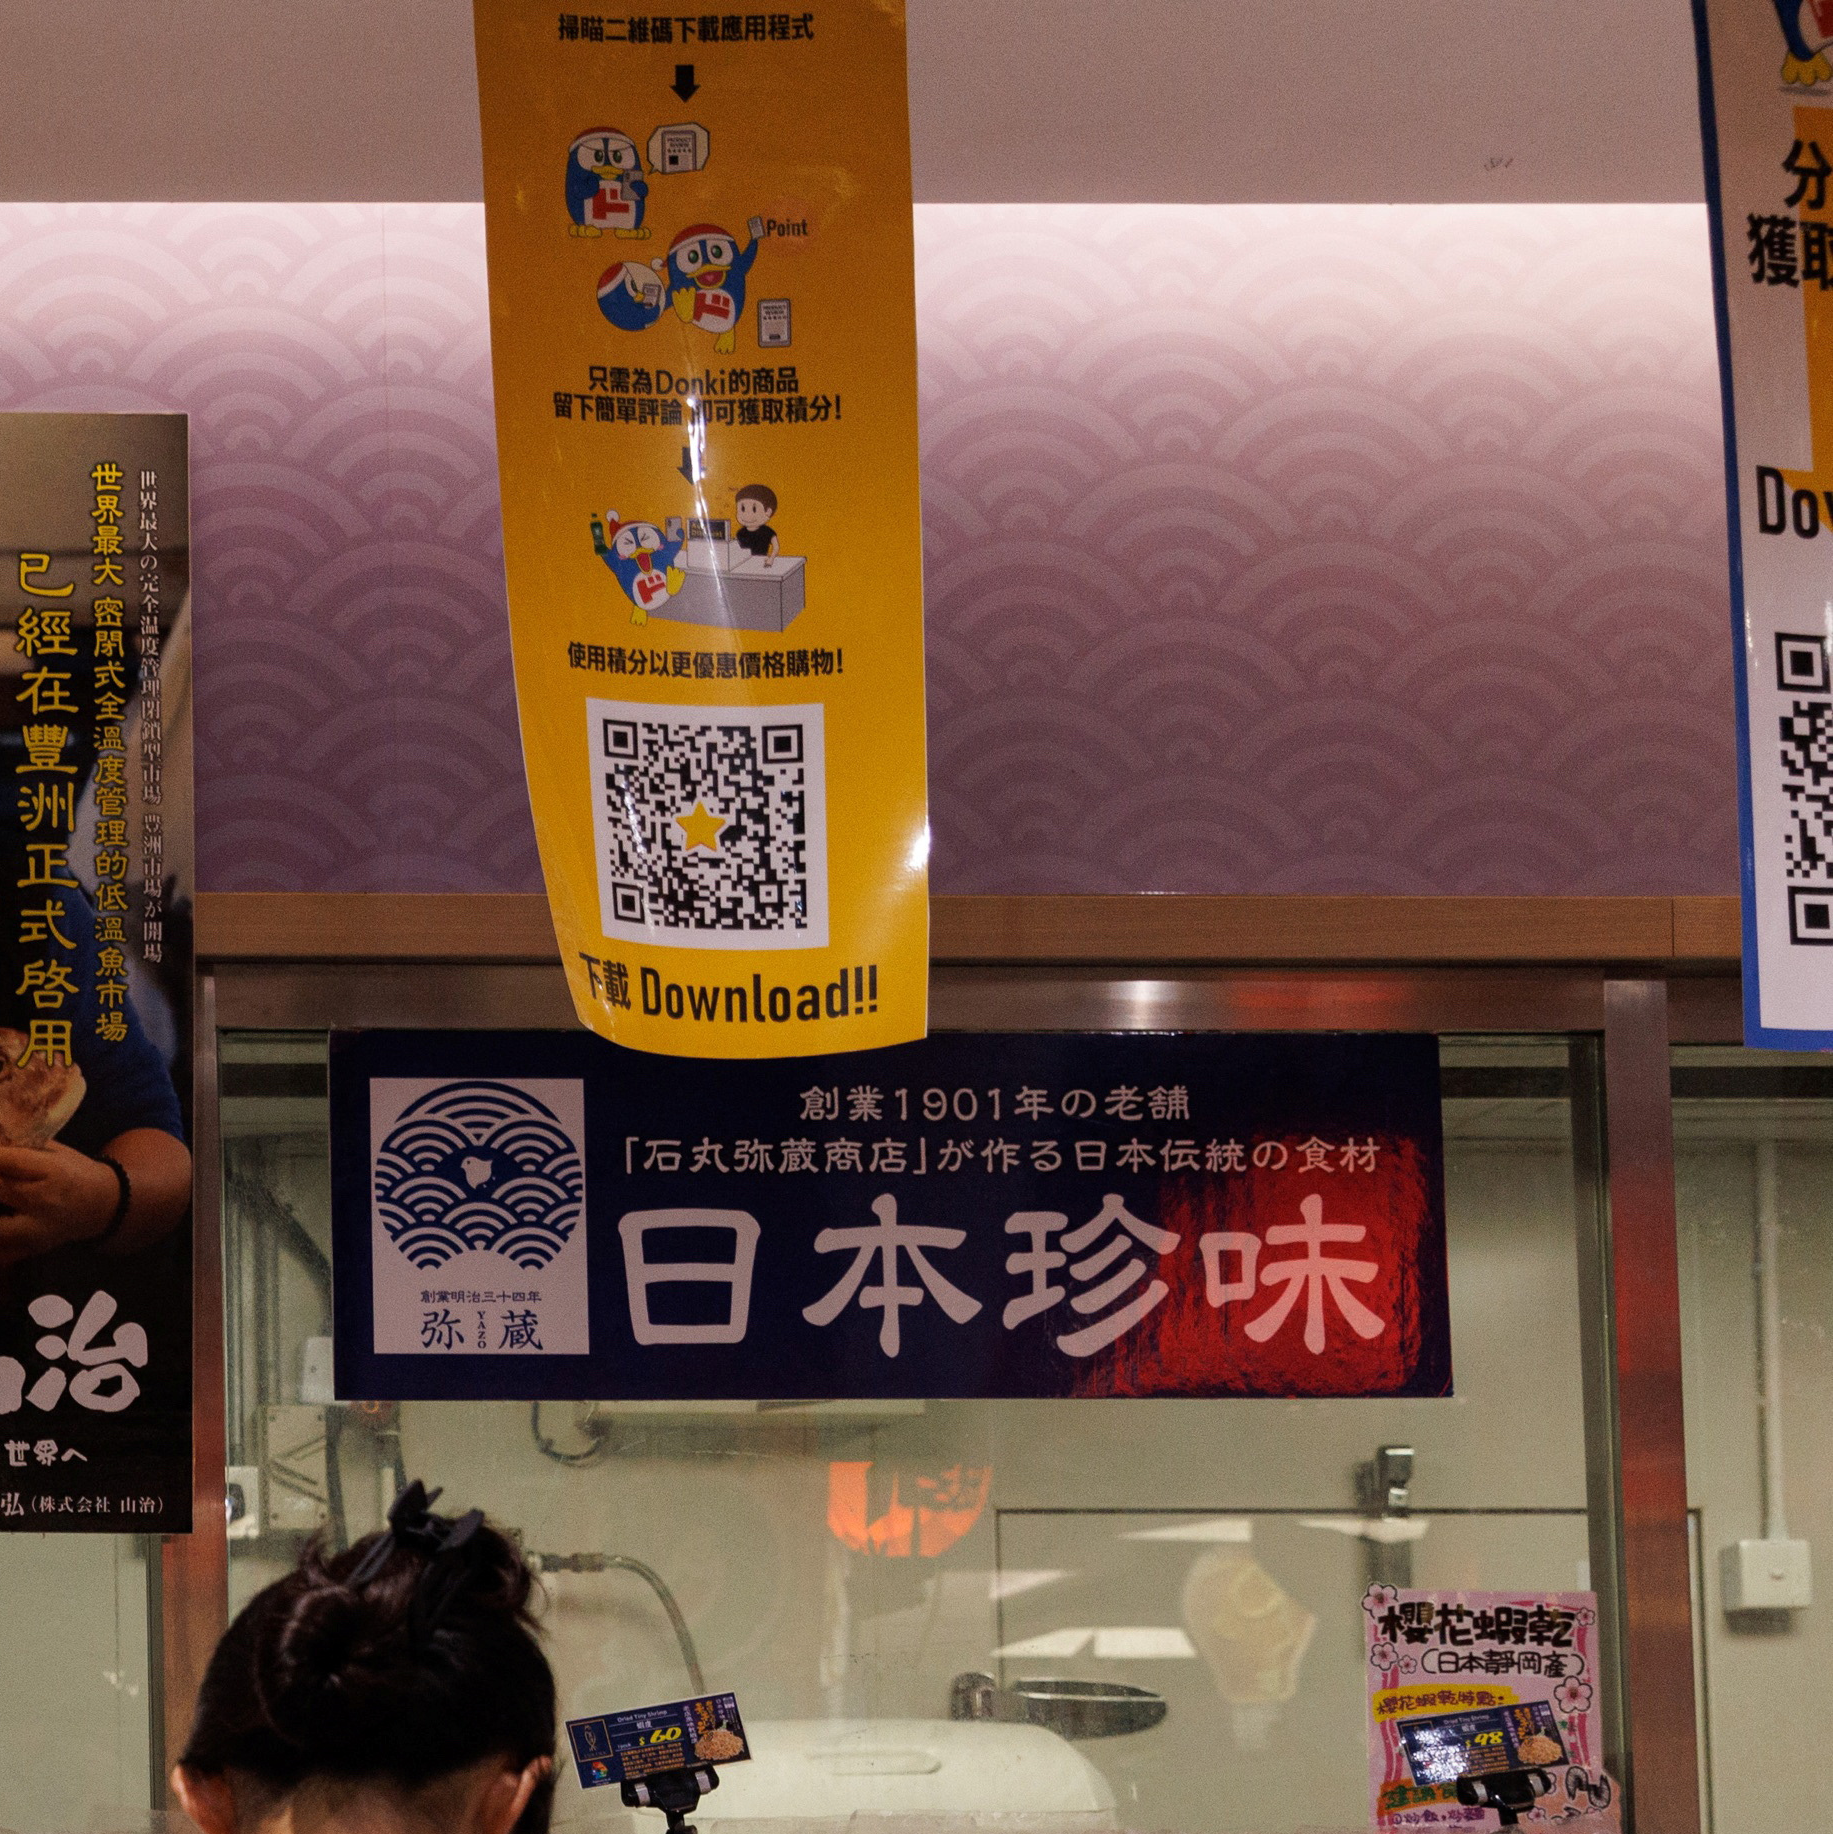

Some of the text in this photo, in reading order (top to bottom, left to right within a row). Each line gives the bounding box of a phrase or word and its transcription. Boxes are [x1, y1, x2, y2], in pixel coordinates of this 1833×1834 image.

[558, 14, 815, 43] 掃瞄二維碼下載應用程式
[766, 219, 807, 238] Point
[588, 366, 799, 395] 只需為Donki的商品
[553, 392, 683, 424] 留下簡單評論
[92, 464, 124, 586] 世界最大
[567, 642, 843, 679] 使用積分以更優惠價格購物!
[580, 951, 877, 1023] 下載 Download!!
[799, 1085, 1191, 1122] 創業1901年の老舗
[624, 1138, 1378, 1174] 「石丸弥蔵商店」が作る日本伝統の食材
[619, 1192, 1387, 1357] 日本珍味
[420, 1289, 543, 1304] 創業明治三十四年
[1378, 1602, 1575, 1647] 櫻花蝦乾
[1421, 1649, 1585, 1678] （日本靜岡產）
[650, 1727, 681, 1743] 60
[1475, 1731, 1504, 1745] 98
